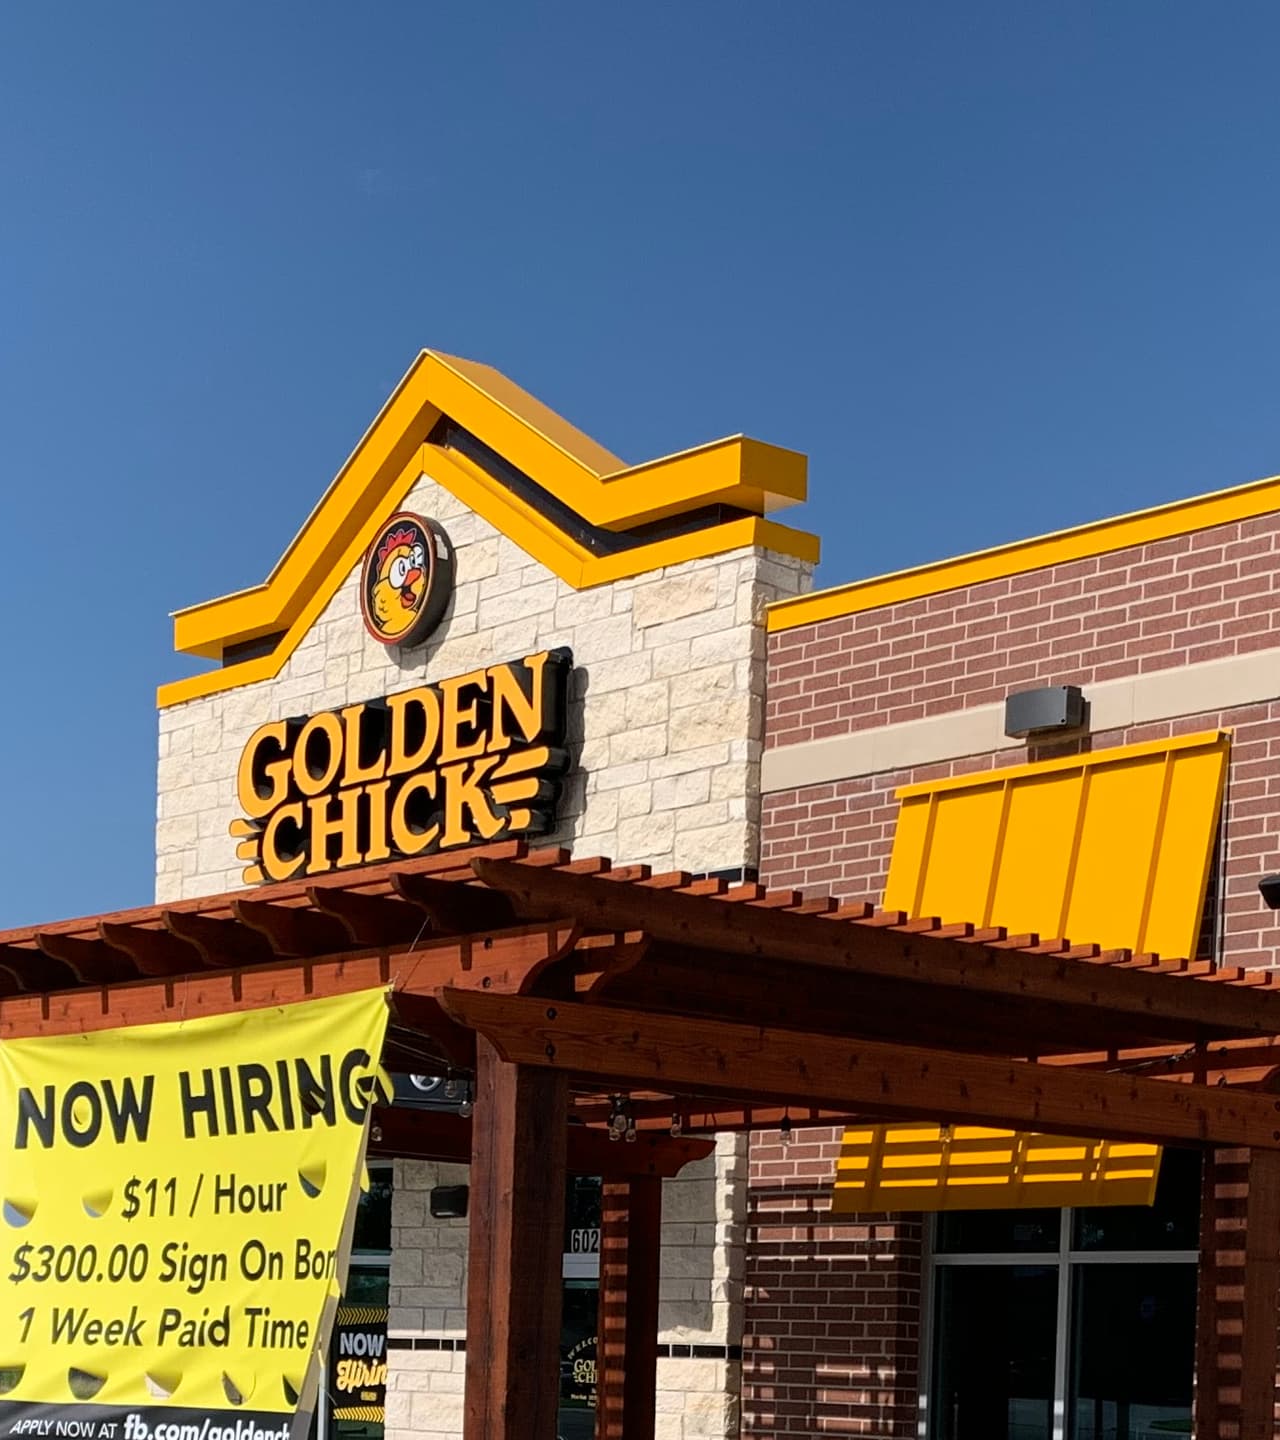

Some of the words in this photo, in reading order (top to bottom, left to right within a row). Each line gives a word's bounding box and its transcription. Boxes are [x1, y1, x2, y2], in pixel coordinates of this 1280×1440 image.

[237, 650, 551, 819] GOLDEN
[261, 759, 507, 882] CHICK
[14, 1074, 155, 1149] NOW
[179, 1048, 388, 1138] HIRING
[121, 1174, 178, 1222] $11
[189, 1173, 204, 1218] /
[214, 1173, 287, 1217] Hour
[572, 1229, 599, 1253] 602
[8, 1241, 148, 1286] $300.00
[158, 1241, 227, 1294] Sign
[240, 1239, 284, 1281] On
[294, 1238, 336, 1280] Bon
[17, 1306, 35, 1344] 1
[51, 1306, 145, 1348] Week
[157, 1305, 231, 1349] Paid
[244, 1306, 309, 1349] Time
[339, 1332, 385, 1357] NOW
[567, 1336, 598, 1360] WELCO
[574, 1358, 597, 1373] GOL
[336, 1358, 387, 1394] Hirin
[577, 1371, 598, 1384] CHI
[9, 1419, 55, 1437] APPLY
[55, 1420, 97, 1439] NOW
[97, 1422, 118, 1439] AT
